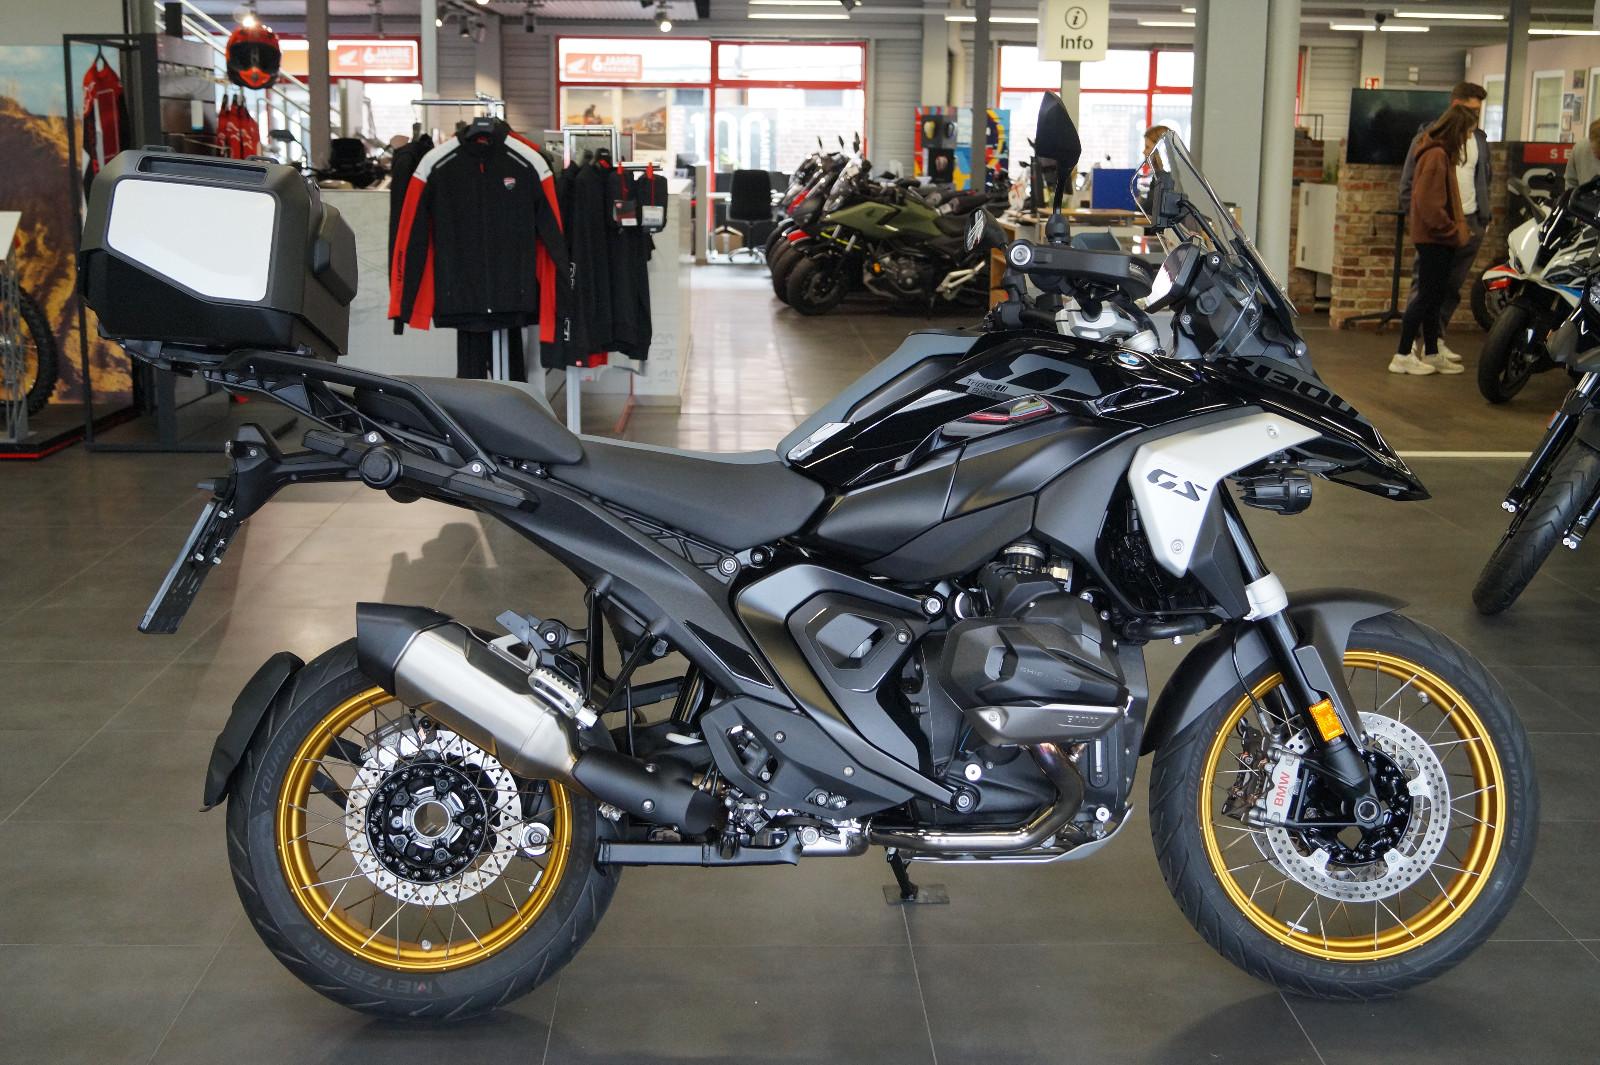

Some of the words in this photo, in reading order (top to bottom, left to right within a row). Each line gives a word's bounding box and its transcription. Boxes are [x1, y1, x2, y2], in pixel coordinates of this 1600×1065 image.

[1060, 34, 1093, 50] Info
[966, 378, 993, 391] Triple
[1146, 468, 1208, 502] GS
[1273, 771, 1291, 807] BMW
[310, 940, 433, 994] METZELER
